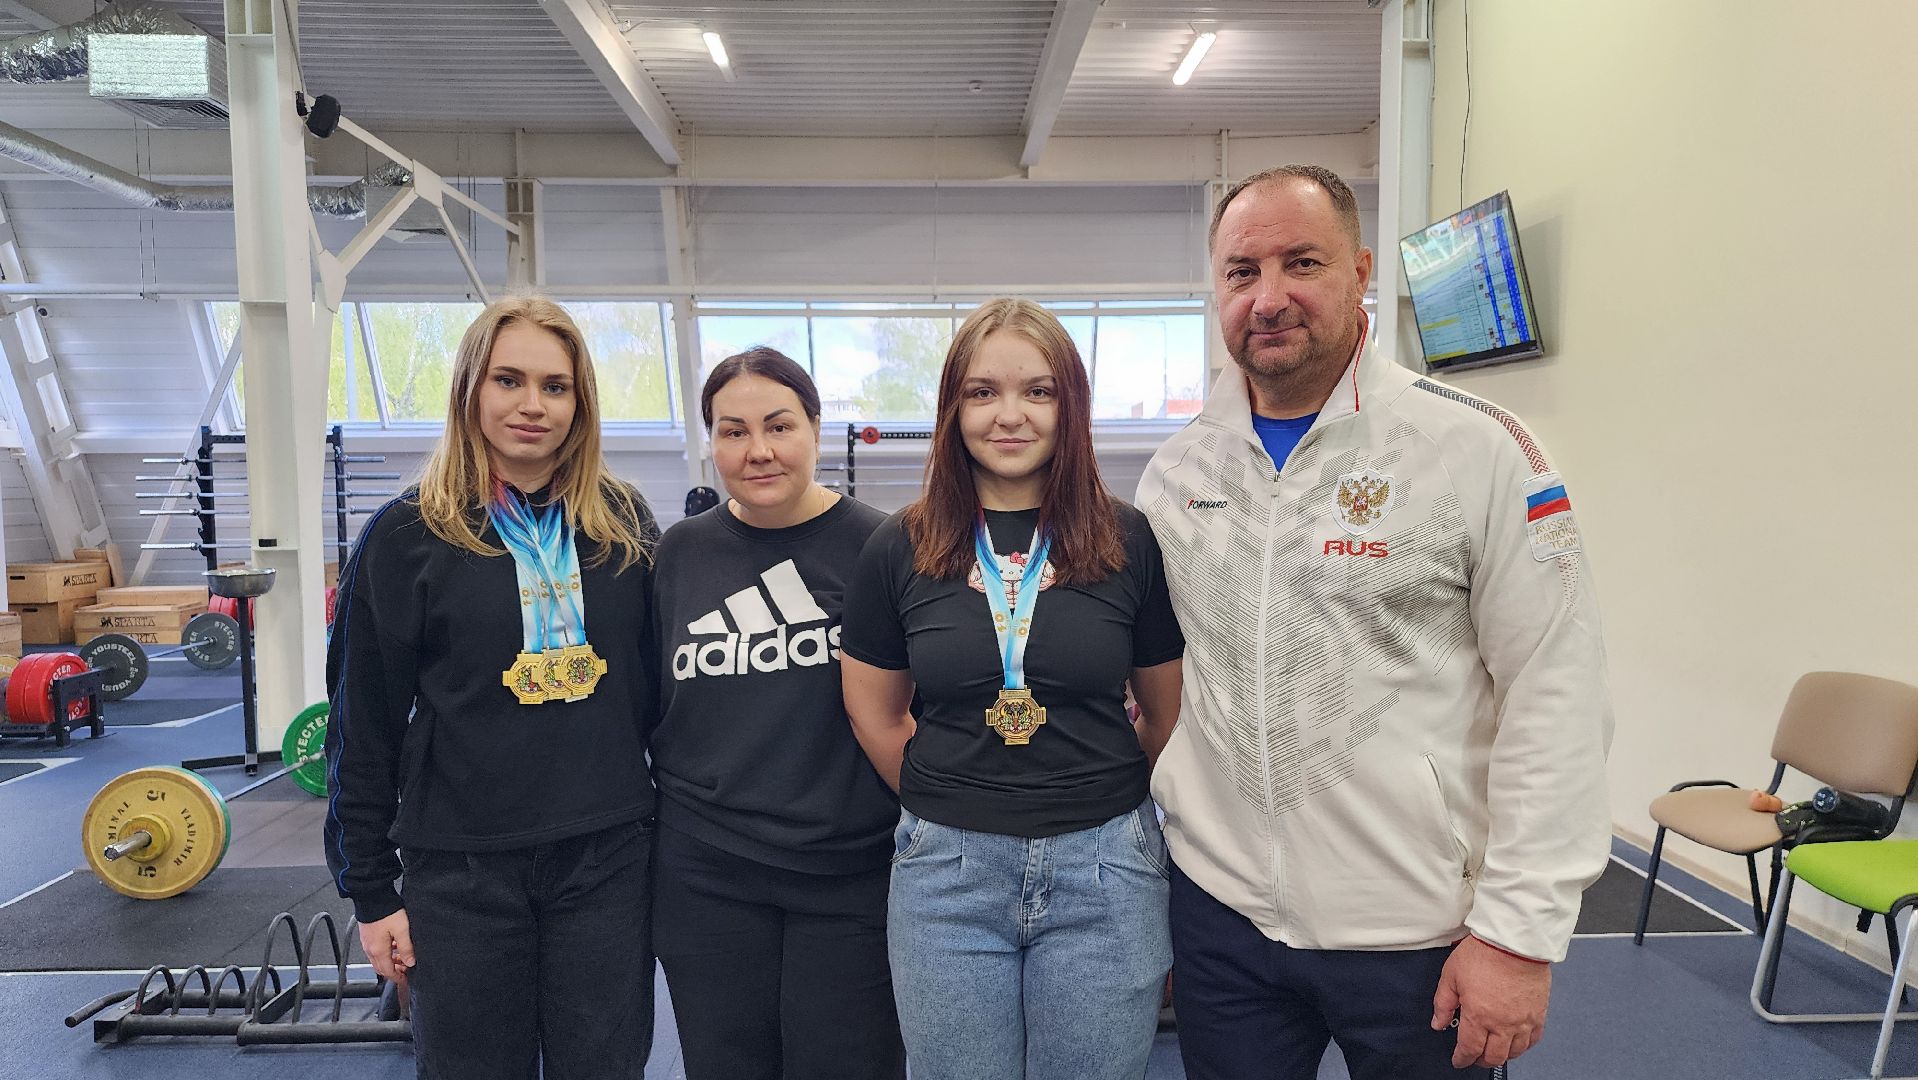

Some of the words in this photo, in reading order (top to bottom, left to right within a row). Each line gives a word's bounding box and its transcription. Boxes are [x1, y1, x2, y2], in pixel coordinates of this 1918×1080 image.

[1187, 500, 1228, 510] FORWARD
[1535, 527, 1578, 545] NATIONA
[1550, 537, 1578, 549] TEAM
[1324, 540, 1389, 558] RUS
[114, 616, 156, 628] SPARTA
[190, 631, 210, 661] STECER
[214, 621, 236, 651] STECTER
[91, 643, 136, 665] YOUSTEEL
[672, 623, 842, 681] adidas
[173, 808, 197, 867] VLADIMIR
